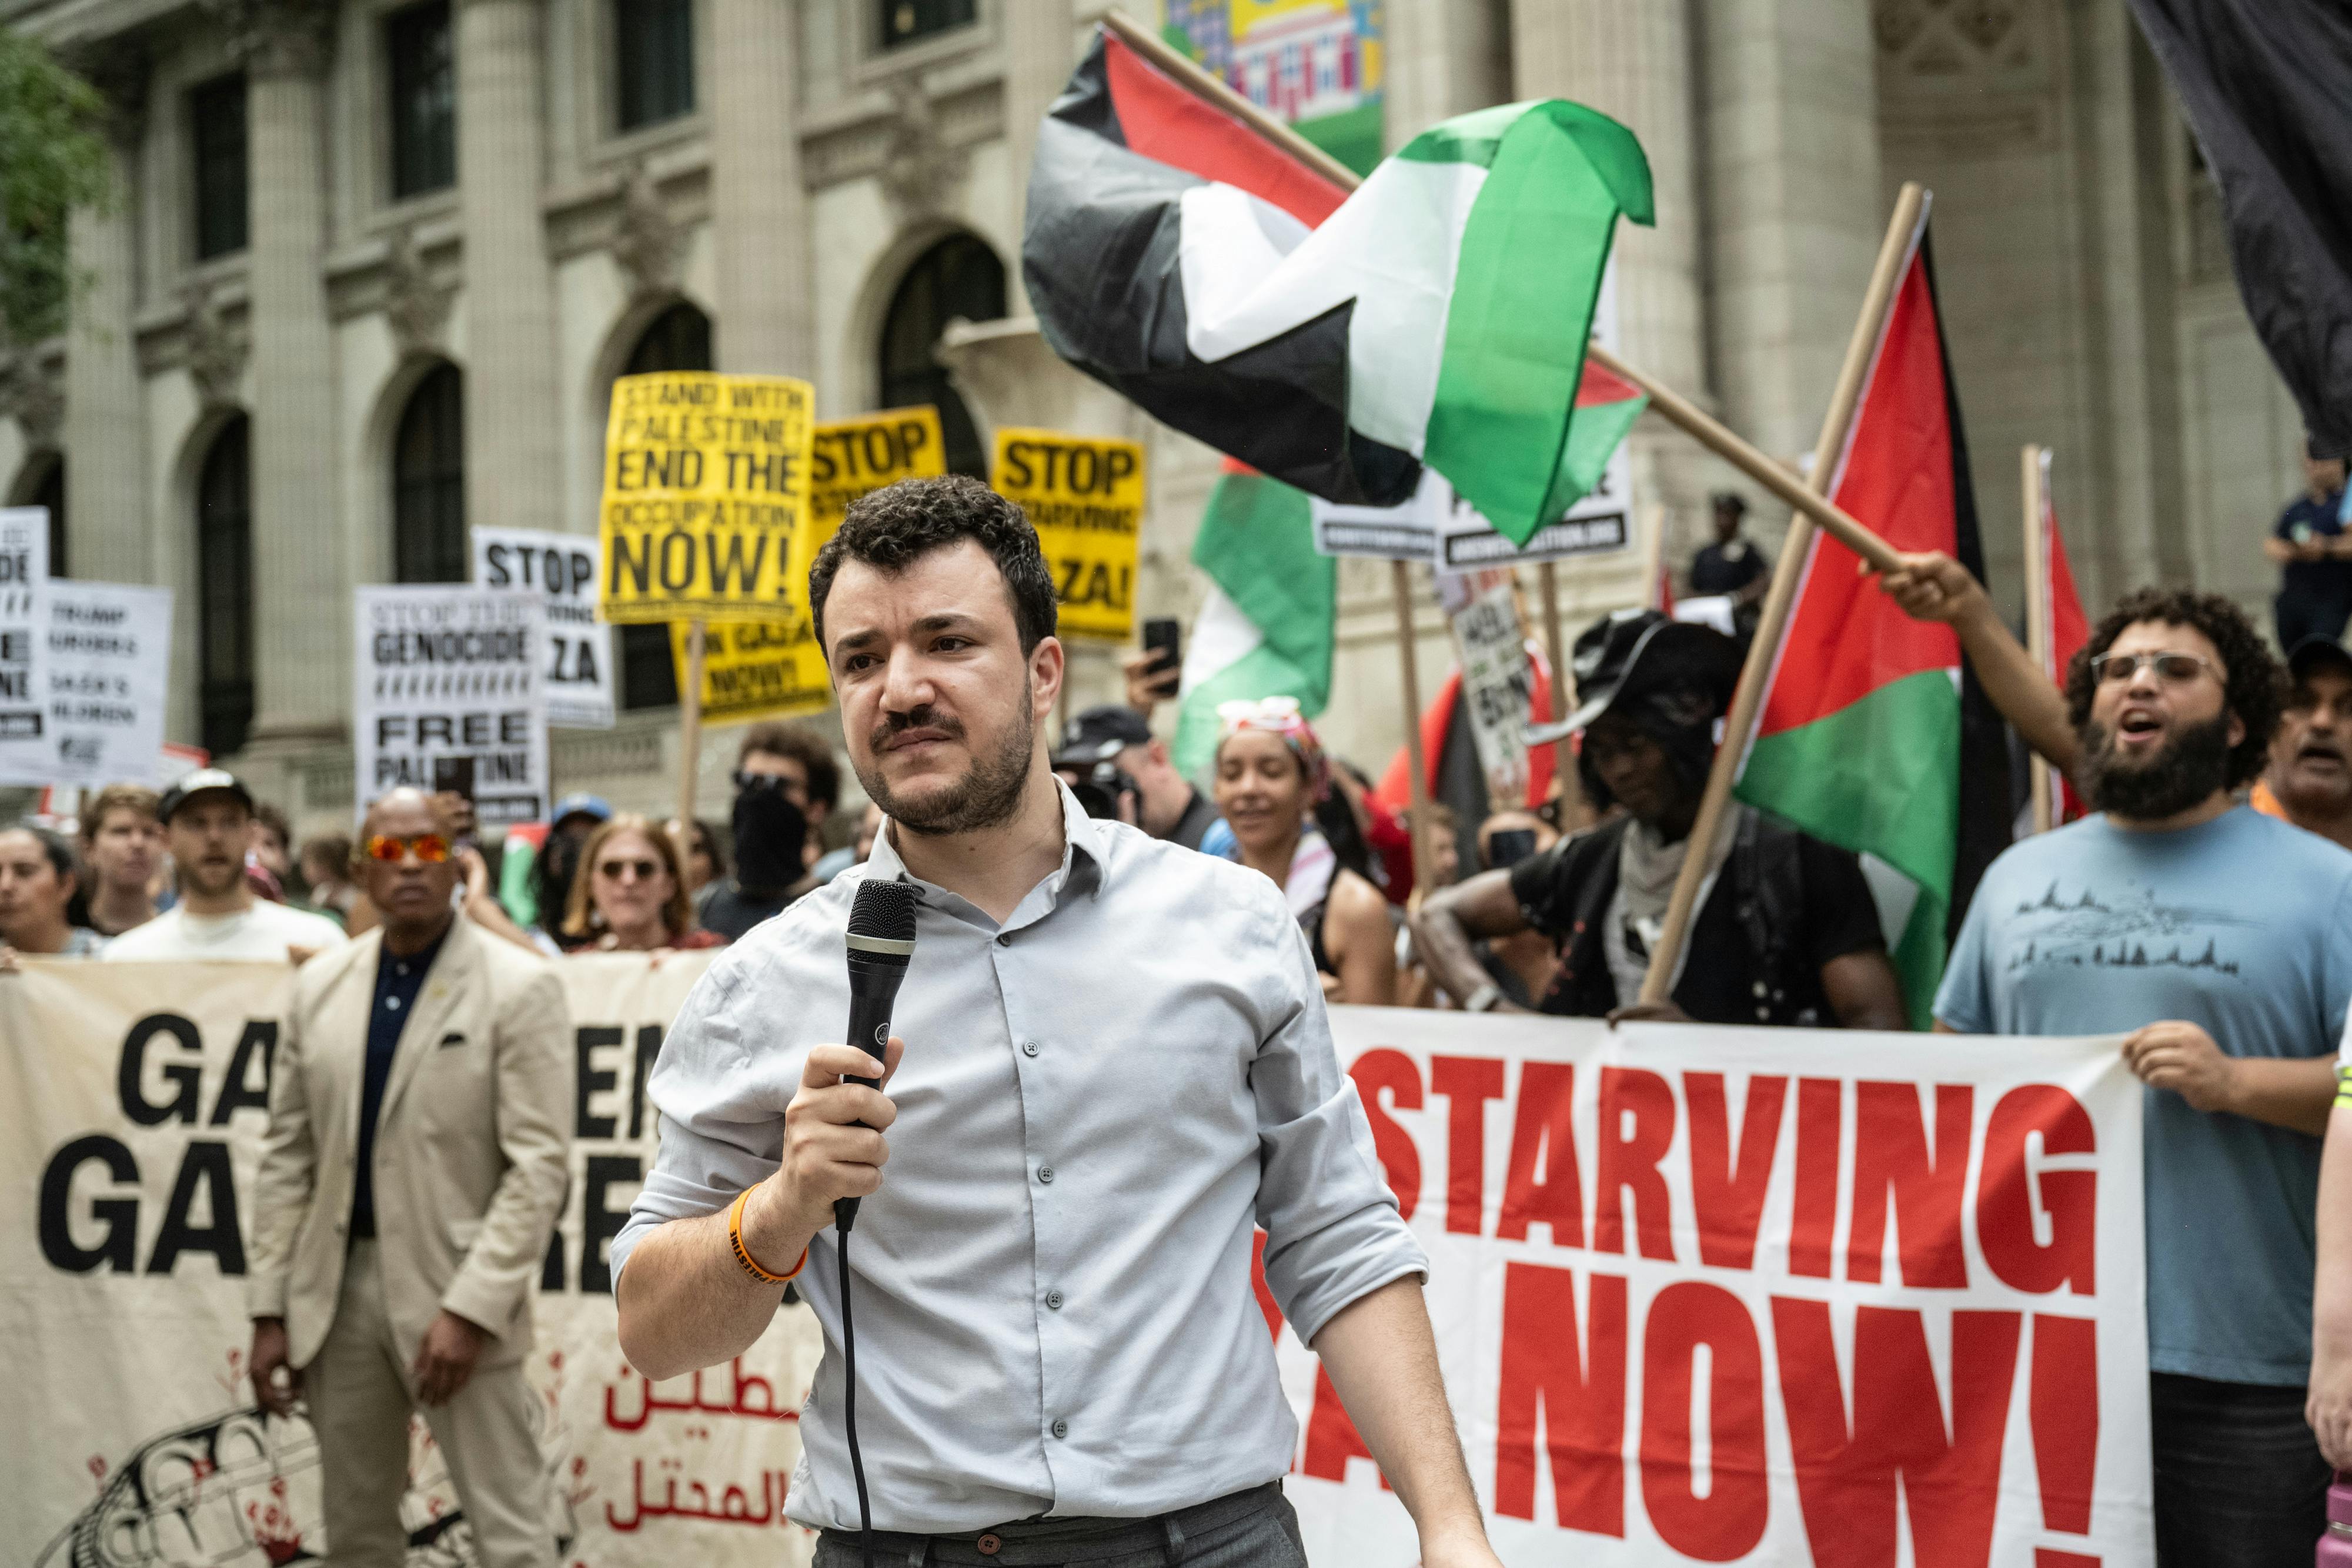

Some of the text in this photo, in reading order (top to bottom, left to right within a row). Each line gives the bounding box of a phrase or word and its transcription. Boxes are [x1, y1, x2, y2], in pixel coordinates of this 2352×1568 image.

[626, 382, 803, 410] STAND WITH
[617, 449, 799, 496] END THE
[812, 421, 927, 482] STOP
[1004, 440, 1135, 496] STOP
[610, 500, 796, 529] OCCUPATION
[486, 543, 593, 595] STOP
[612, 529, 789, 596] NOW!
[1059, 558, 1130, 611] ZA!
[373, 628, 528, 665] GENOCIDE
[547, 637, 599, 684] ZA
[377, 713, 529, 746] FREE
[1344, 1047, 2097, 1297] STARVING
[730, 1229, 770, 1283] PALESTINE
[1494, 1260, 2100, 1568] NOW!
